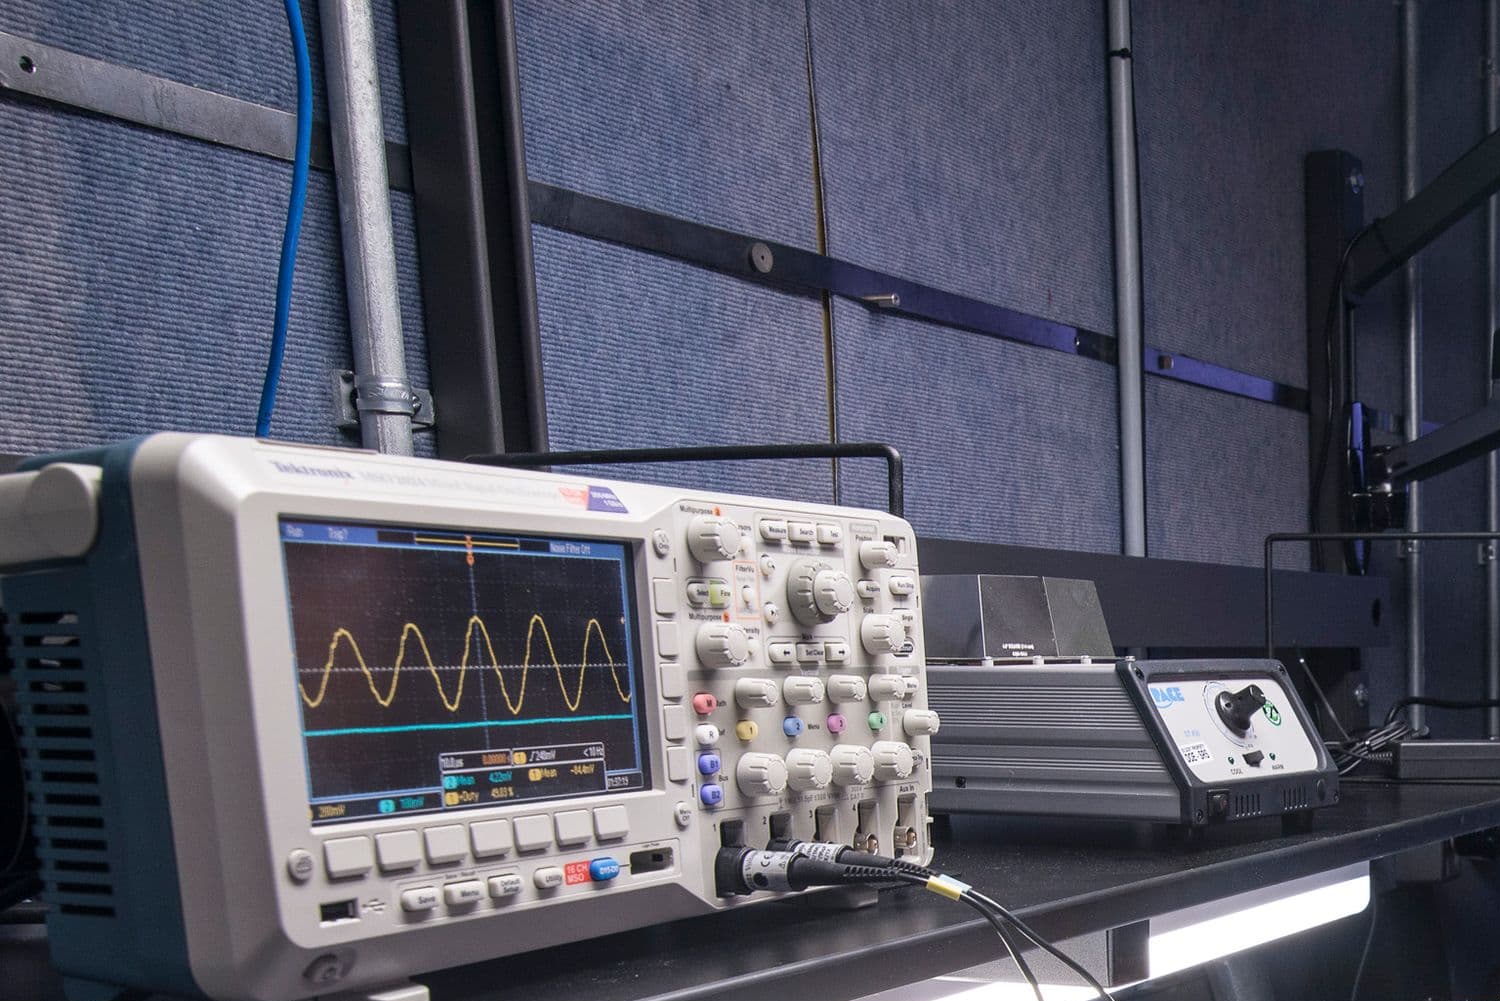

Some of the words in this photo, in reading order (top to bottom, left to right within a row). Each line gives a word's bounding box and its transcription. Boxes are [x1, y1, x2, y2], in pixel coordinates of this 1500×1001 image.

[270, 460, 354, 479] Tektronix
[769, 526, 786, 534] Measure
[800, 528, 814, 536] Search
[550, 541, 565, 552] Noise
[566, 543, 581, 554] Filter
[710, 761, 718, 769] B1
[711, 791, 720, 800] B2
[567, 866, 576, 874] 16
[577, 864, 588, 873] CH
[567, 874, 585, 883] MSO
[461, 890, 480, 898] Menu
[418, 896, 435, 905] Save
